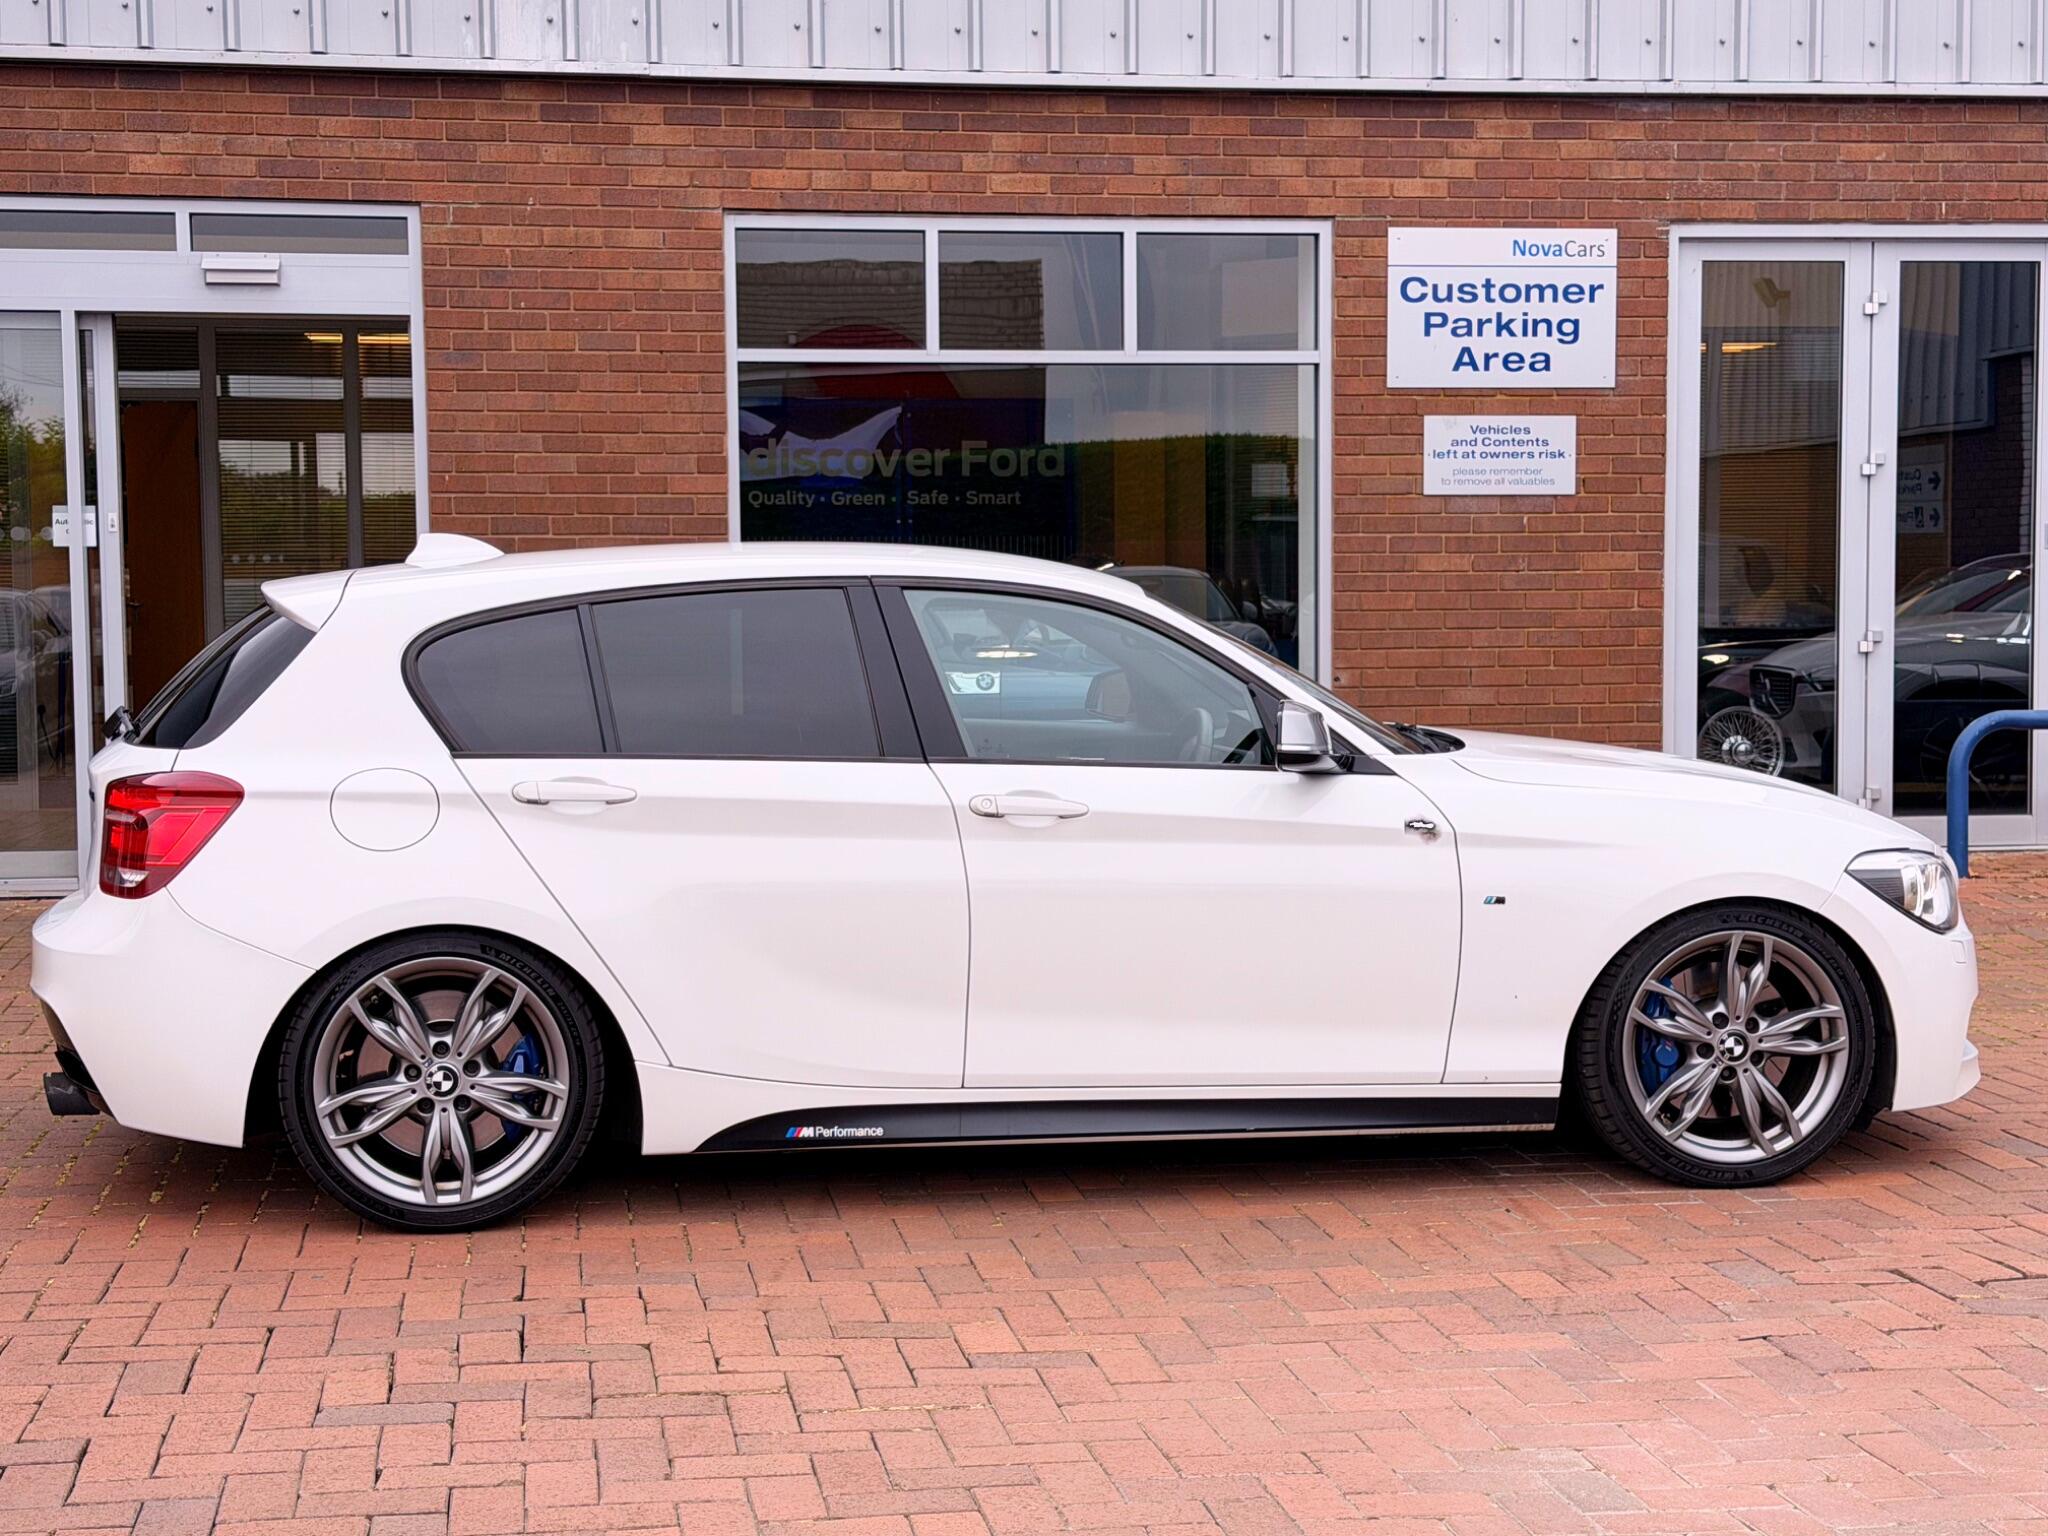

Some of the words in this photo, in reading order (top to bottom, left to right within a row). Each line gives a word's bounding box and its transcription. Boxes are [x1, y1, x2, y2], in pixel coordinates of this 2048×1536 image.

[1512, 239, 1606, 258] NovaCars
[1400, 276, 1604, 303] Customer
[1424, 312, 1580, 345] Parking
[1452, 347, 1551, 372] Area
[1470, 425, 1531, 435] Vehicles
[1450, 437, 1478, 447] and
[1481, 437, 1550, 447] Contents
[750, 438, 950, 478] discover
[961, 441, 1065, 477] Ford
[1432, 450, 1457, 459] left
[1461, 450, 1476, 459] at
[1479, 451, 1535, 459] owners
[1538, 449, 1566, 459] risk
[1452, 467, 1486, 477] please
[1489, 466, 1543, 475] remember
[1441, 477, 1451, 486] to
[1453, 478, 1492, 486] remove
[1508, 477, 1555, 486] valuables
[815, 1126, 884, 1137] Performance
